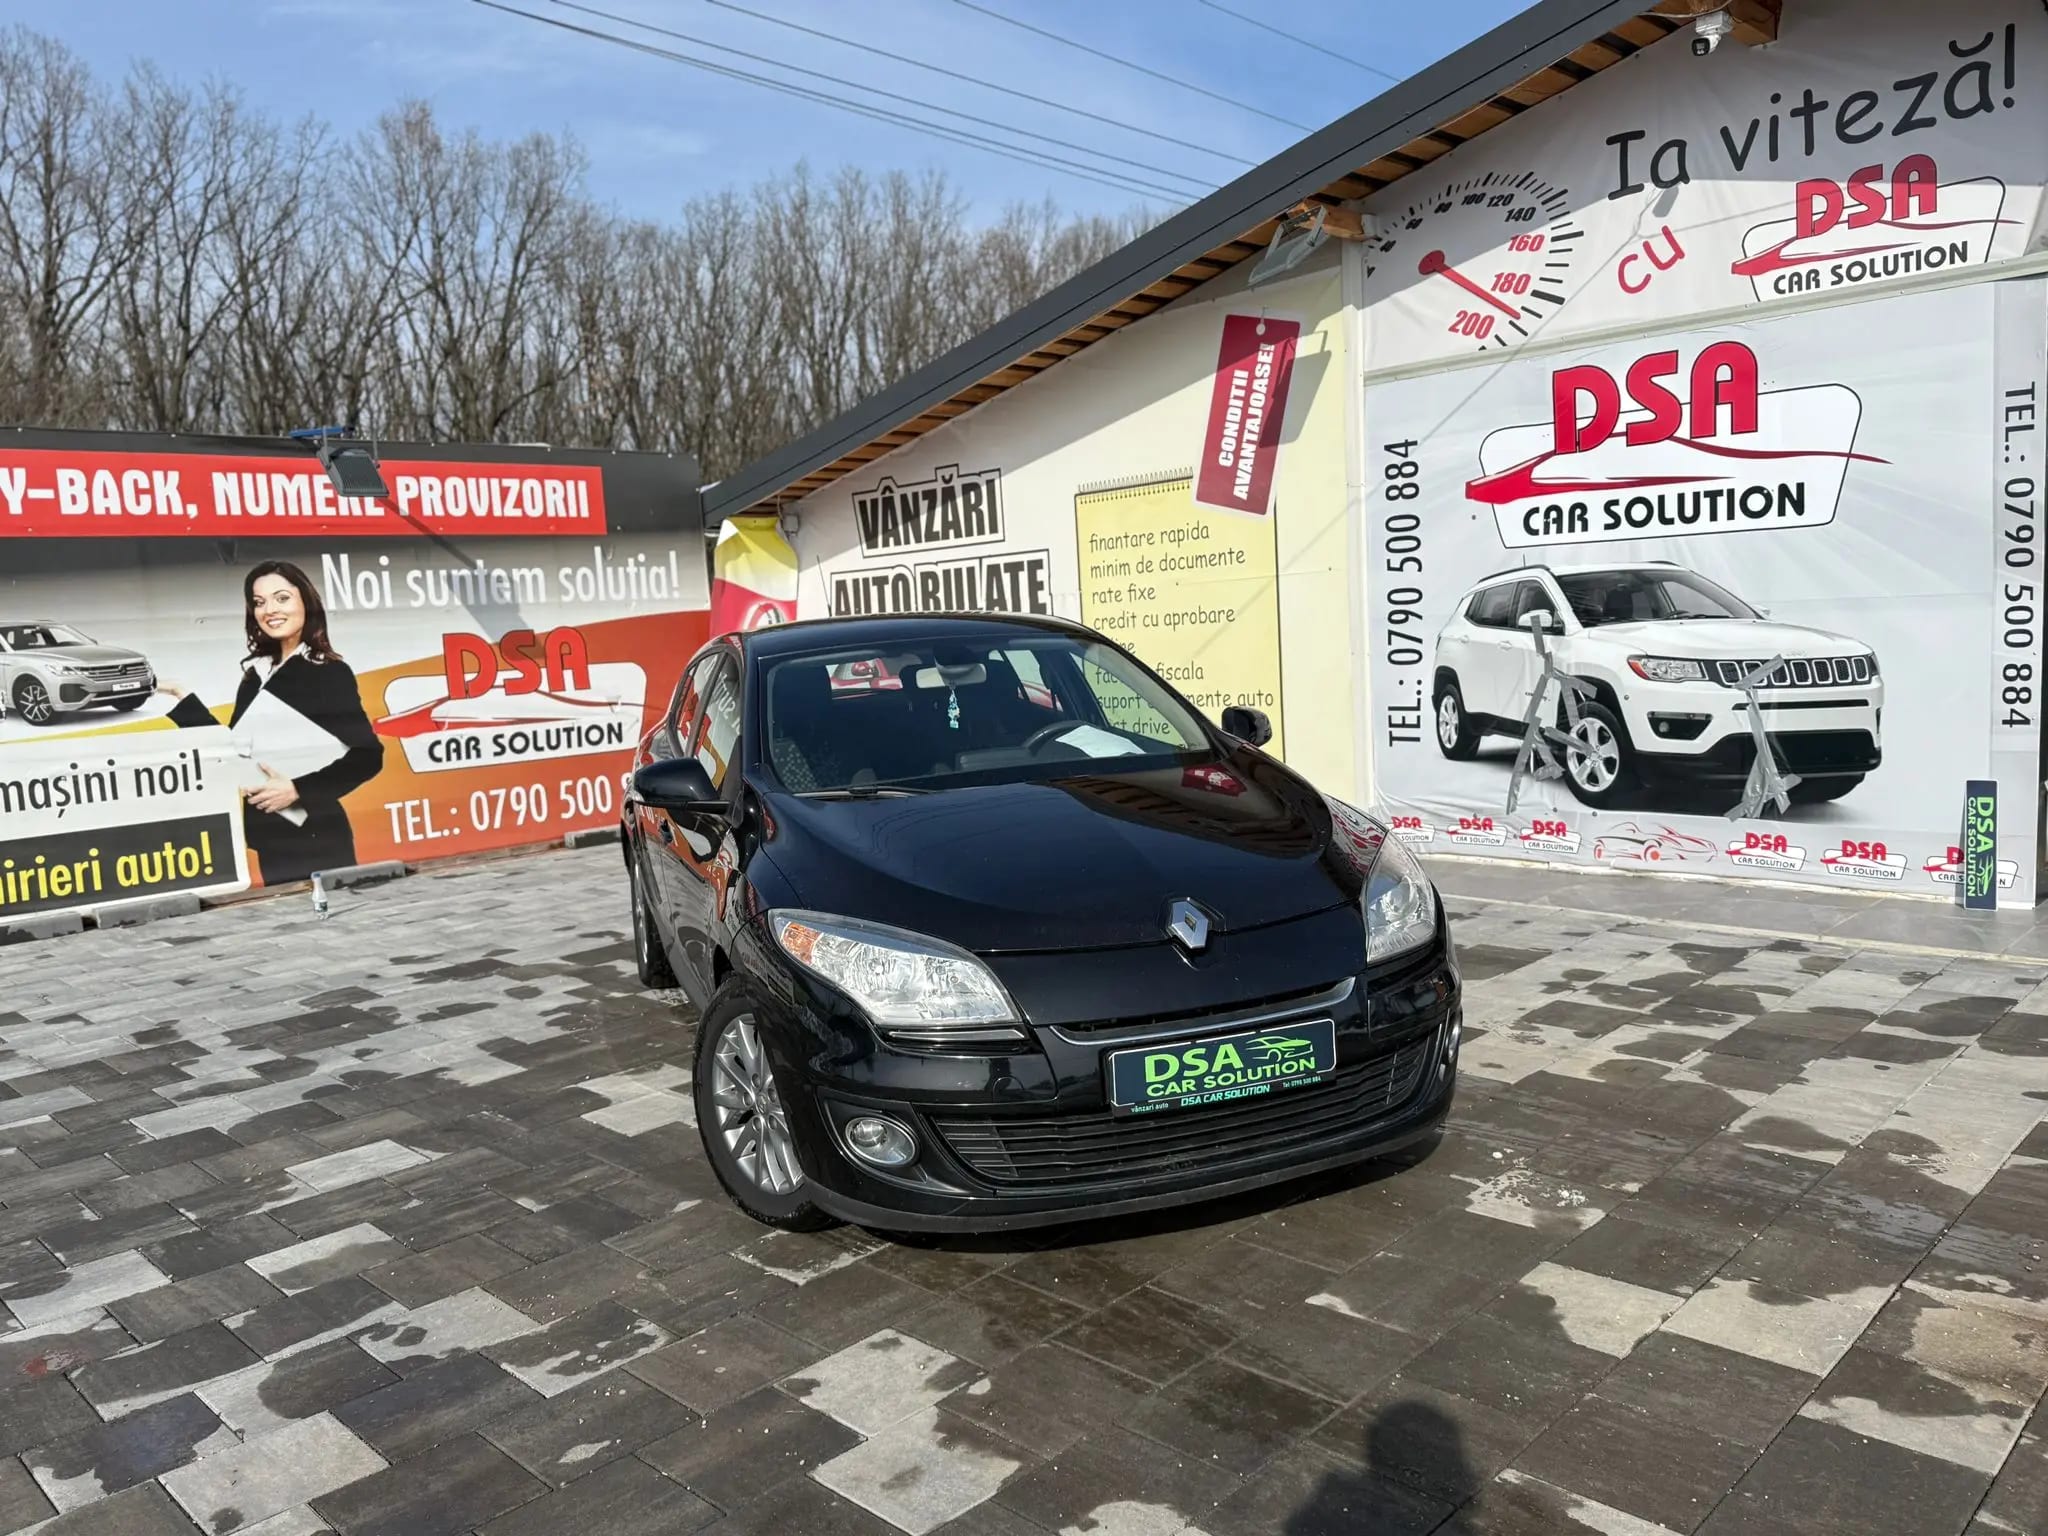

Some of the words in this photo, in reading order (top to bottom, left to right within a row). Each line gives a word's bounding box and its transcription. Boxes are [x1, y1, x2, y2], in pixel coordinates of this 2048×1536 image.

[1606, 129, 1690, 200] Ia
[1719, 23, 2015, 172] viteză!
[1486, 193, 1515, 208] 120
[1504, 206, 1536, 222] 140
[1795, 154, 1938, 240] DSA
[1507, 234, 1545, 252] 160
[1618, 225, 1685, 294] cu
[1490, 272, 1532, 295] 180
[1773, 272, 1820, 295] CAR
[1830, 240, 1969, 286] SOLUTION
[1448, 310, 1495, 340] 200
[1552, 340, 1758, 455] DSA
[1218, 369, 1249, 468] CONDITII
[2004, 381, 2035, 464] TEL.:
[1383, 439, 1419, 502] 884
[395, 476, 589, 518] PROVIZORII
[858, 473, 999, 550] VÂNZĂRI
[1523, 503, 1589, 536] CAR
[1603, 482, 1806, 531] SOLUTION
[1089, 530, 1155, 553] finantare
[1160, 520, 1210, 548] rapida
[1385, 513, 1423, 573] 500
[2004, 477, 2035, 568] 0790
[321, 553, 394, 611] Noi
[406, 559, 546, 607] suntem
[1090, 560, 1131, 579] minim
[1136, 553, 1154, 574] de
[1159, 547, 1246, 572] documente
[1092, 587, 1122, 605] rate
[1127, 583, 1156, 603] fixe
[1093, 611, 1137, 631] credit
[1142, 613, 1159, 628] cu
[1163, 605, 1236, 632] aprobare
[1387, 587, 1423, 665] 0790
[2003, 583, 2035, 649] 500
[442, 626, 591, 700] DSA
[1237, 689, 1274, 708] auto
[1387, 679, 1423, 747] TEL.:
[2001, 663, 2033, 728] 884
[428, 734, 482, 763] CAR
[492, 722, 623, 757] SOLUTION
[1133, 718, 1171, 735] drive
[134, 749, 203, 798] noi!
[384, 800, 461, 844] TEL.:
[469, 783, 548, 832] 0790
[560, 775, 613, 819] 500
[1391, 816, 1423, 829] DSA
[1459, 817, 1494, 831] DSA
[1532, 819, 1567, 837] DSA
[1967, 796, 1977, 825] CAR
[1976, 796, 1994, 853] DSA
[1469, 836, 1500, 844] SOLUTION
[1528, 842, 1541, 850] CAR
[1542, 842, 1575, 852] SOLUTION
[1745, 832, 1788, 853] DSA
[1841, 840, 1887, 861] DSA
[0, 847, 103, 905] irieri
[116, 831, 213, 888] auto!
[1737, 857, 1753, 866] CAR
[1755, 859, 1796, 869] SOLUTION
[1834, 866, 1850, 874] CAR
[1852, 867, 1897, 878] SOLUTION
[1938, 873, 1956, 882] CAR
[1966, 828, 1977, 897] SOLUTION
[1144, 1043, 1244, 1083] DSA
[1147, 1074, 1198, 1097] CAR
[1203, 1056, 1316, 1089] SOLUTION
[1181, 1096, 1202, 1107] DSA
[1203, 1092, 1223, 1103] CAR
[1224, 1084, 1270, 1100] SOLUTION
